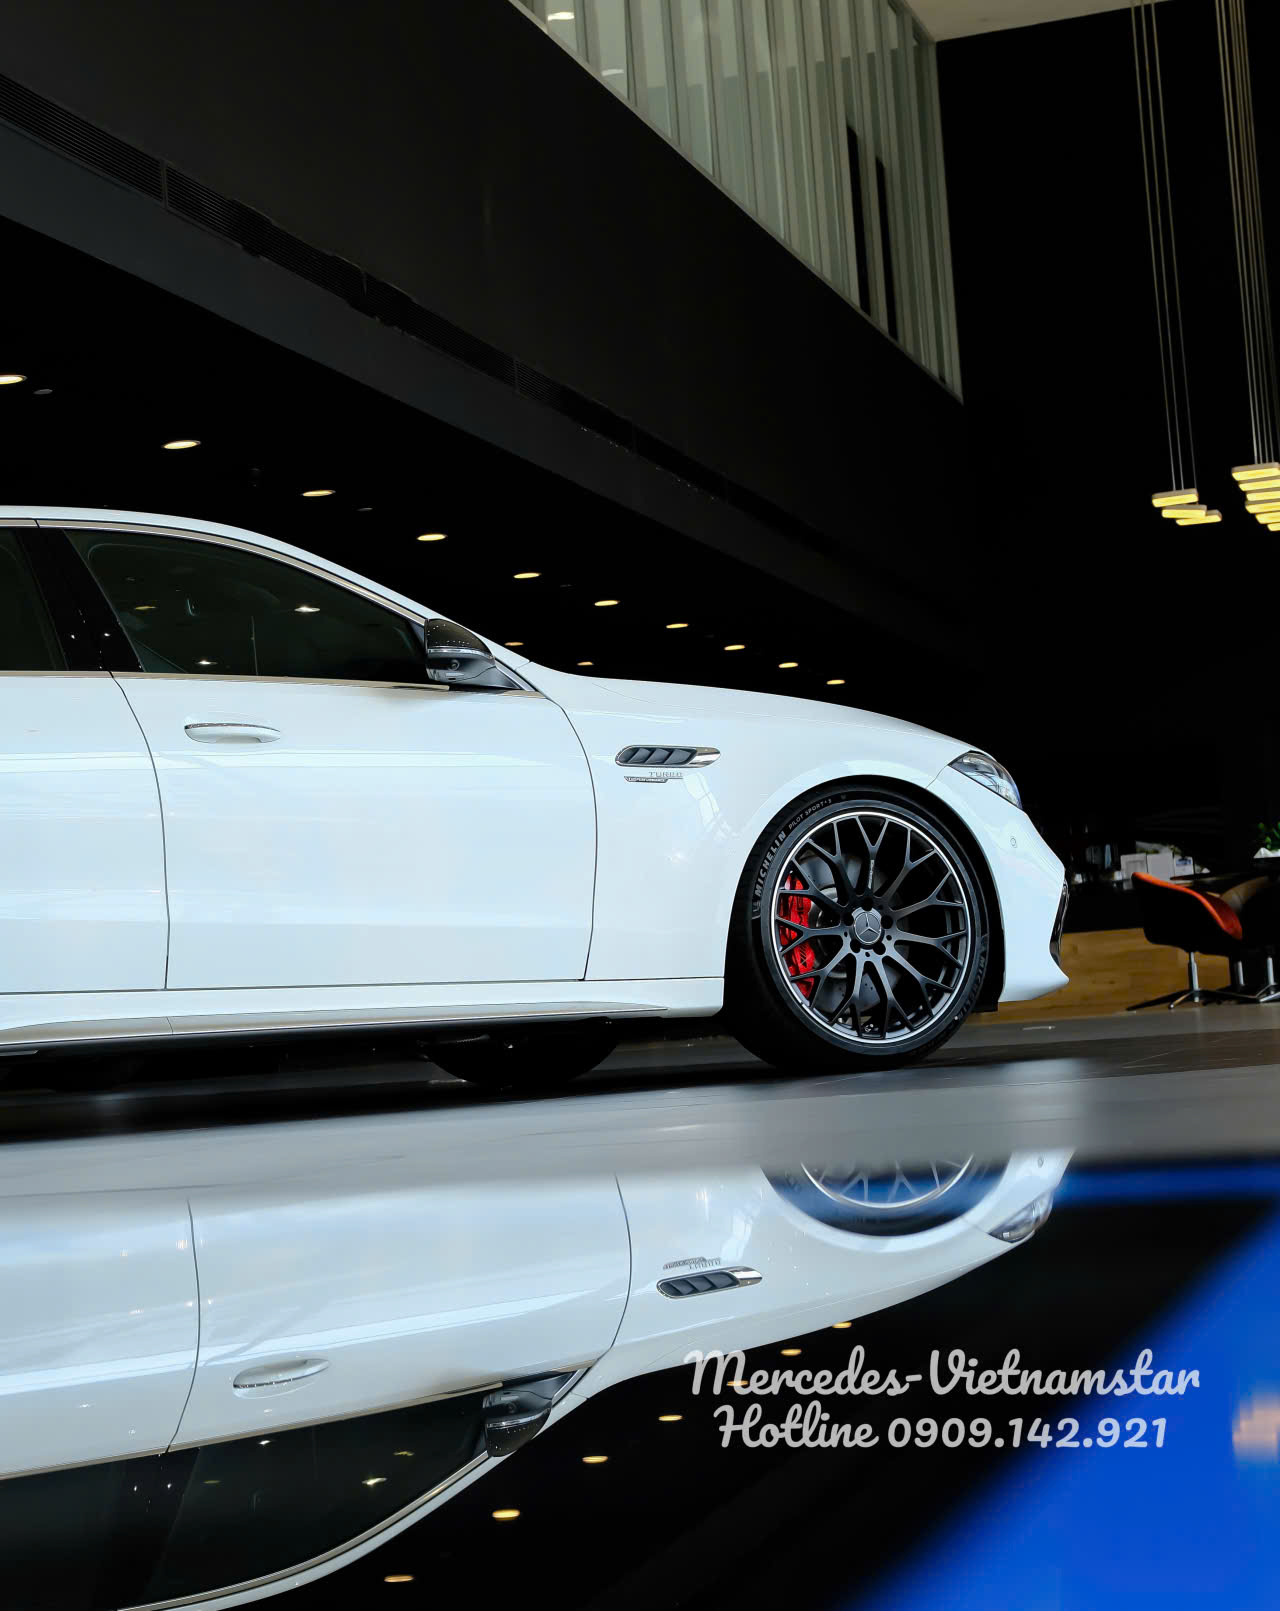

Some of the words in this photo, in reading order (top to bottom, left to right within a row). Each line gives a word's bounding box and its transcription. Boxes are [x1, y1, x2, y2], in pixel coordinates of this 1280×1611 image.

[754, 830, 787, 898] MICHELIN
[788, 813, 804, 830] PILOT
[805, 801, 824, 816] SPORT
